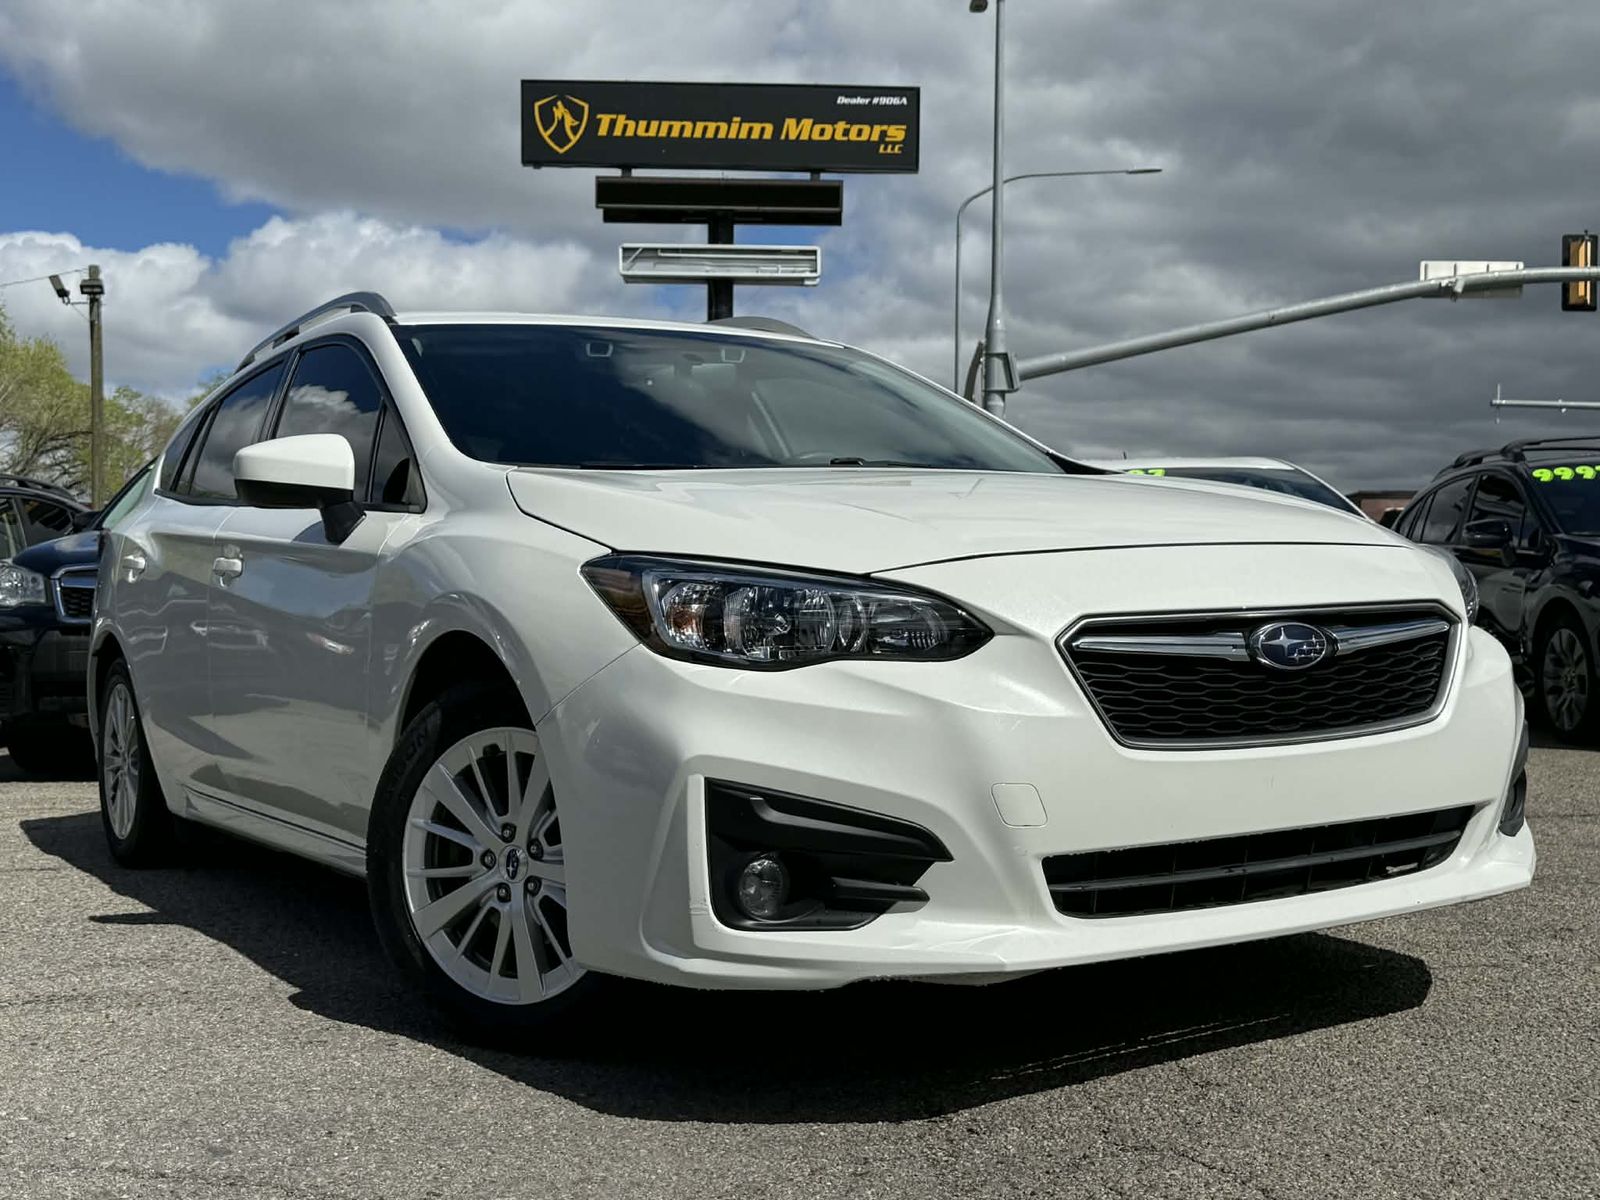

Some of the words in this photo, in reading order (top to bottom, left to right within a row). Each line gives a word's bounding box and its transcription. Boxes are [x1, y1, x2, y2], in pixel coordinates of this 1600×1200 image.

[836, 95, 871, 105] Dealer
[872, 96, 908, 106] #906A
[596, 113, 774, 140] Thummim
[780, 117, 907, 142] Motors
[878, 144, 904, 154] LLC
[1532, 464, 1600, 482] 999
